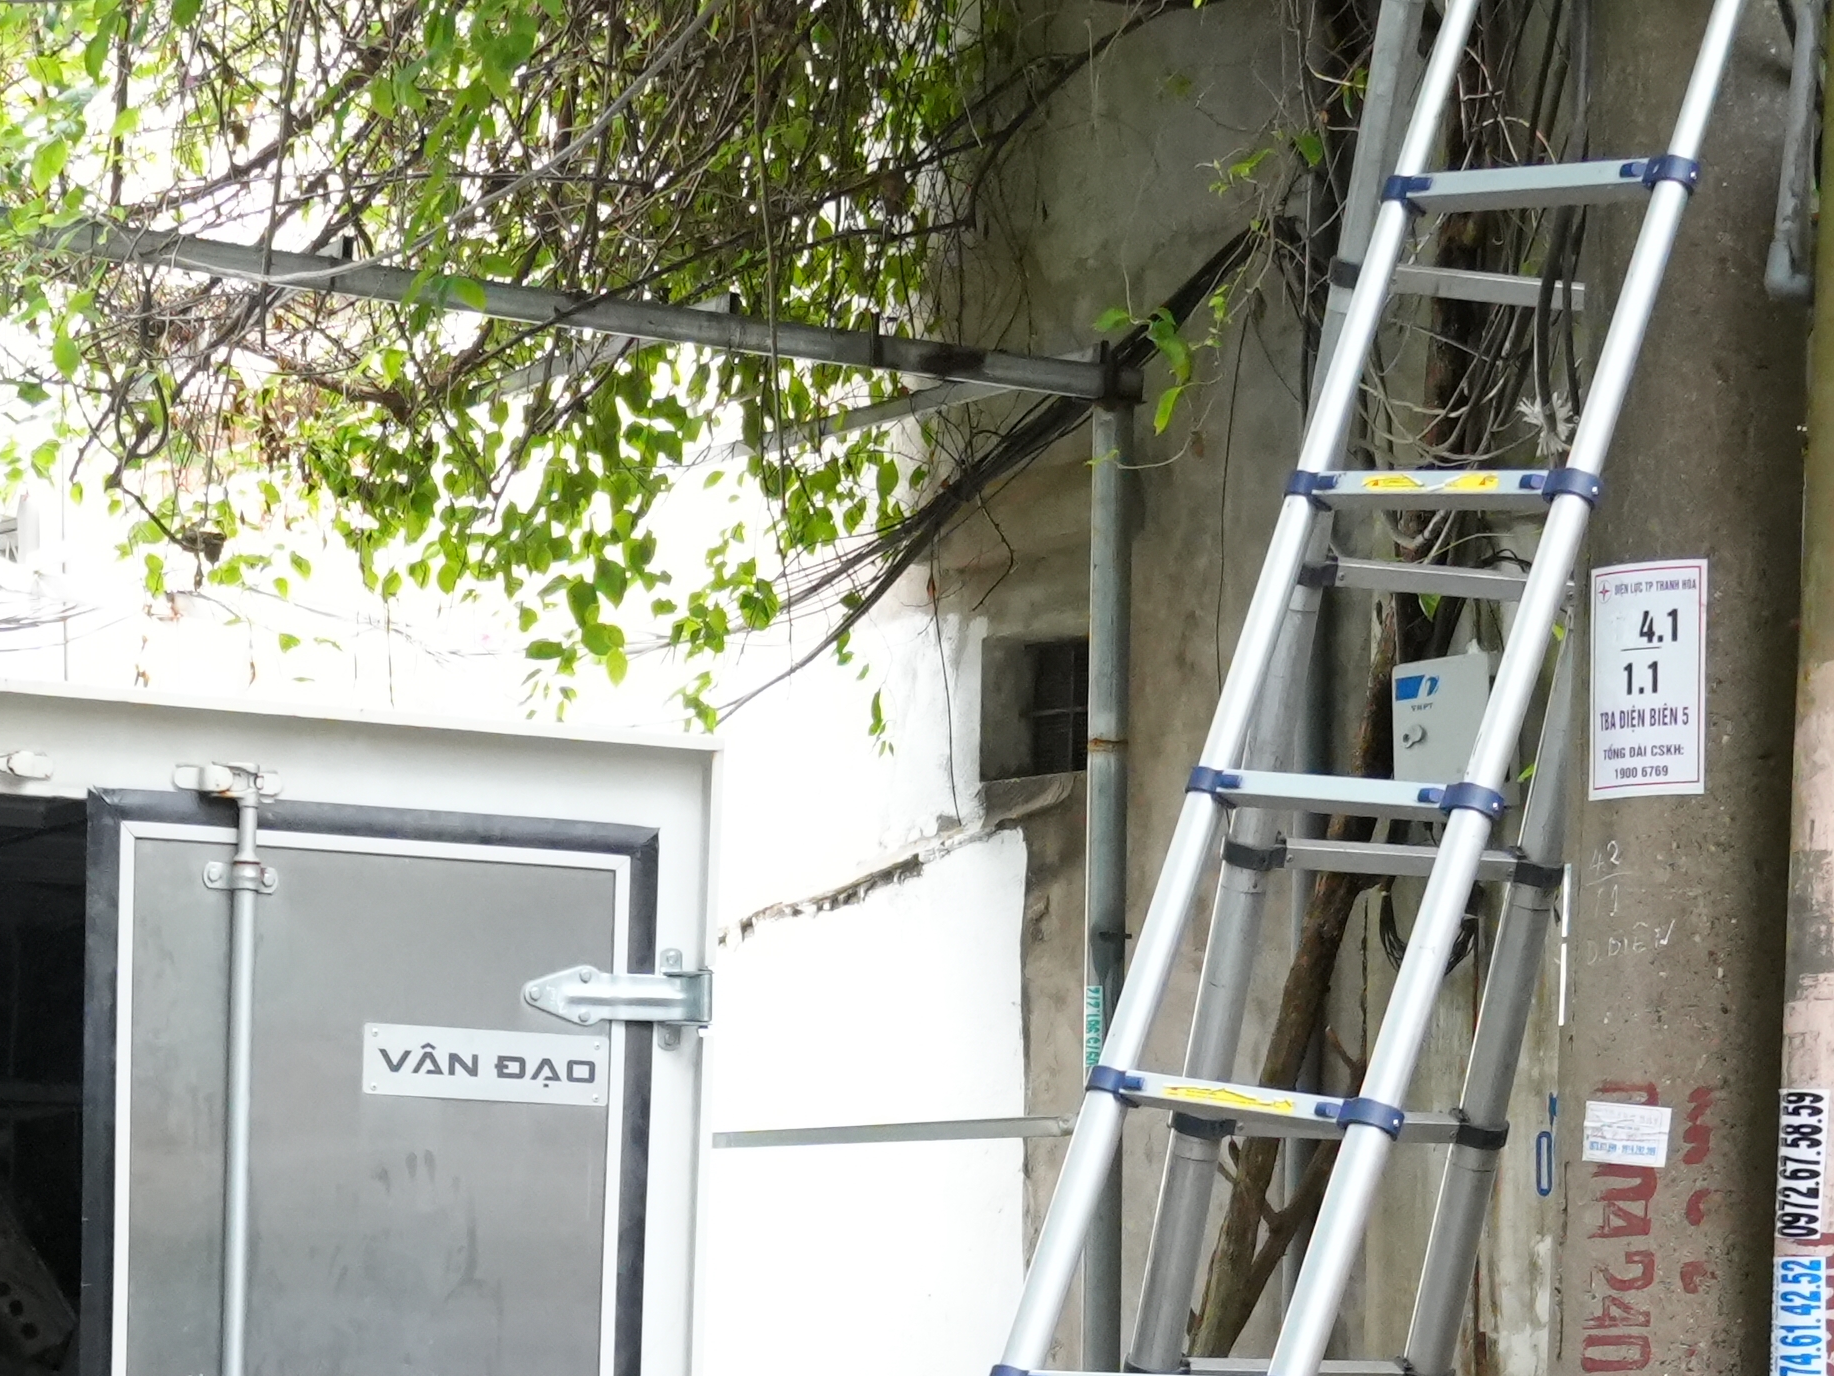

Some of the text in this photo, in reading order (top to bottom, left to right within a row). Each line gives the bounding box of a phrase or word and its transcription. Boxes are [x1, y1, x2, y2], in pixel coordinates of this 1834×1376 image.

[1645, 581, 1654, 592] TP
[1656, 579, 1680, 591] THANH
[1639, 608, 1678, 643] 4.1
[1623, 660, 1659, 696] 1.1
[1600, 711, 1616, 731] TBA
[1650, 702, 1678, 727] BIÊN
[1682, 706, 1689, 725] 5
[1651, 744, 1684, 757] CSKH:
[1615, 765, 1669, 780] 1900 6769
[378, 1042, 596, 1088] VÂN ĐẠO
[1777, 1092, 1826, 1238] 0972.67.58.59
